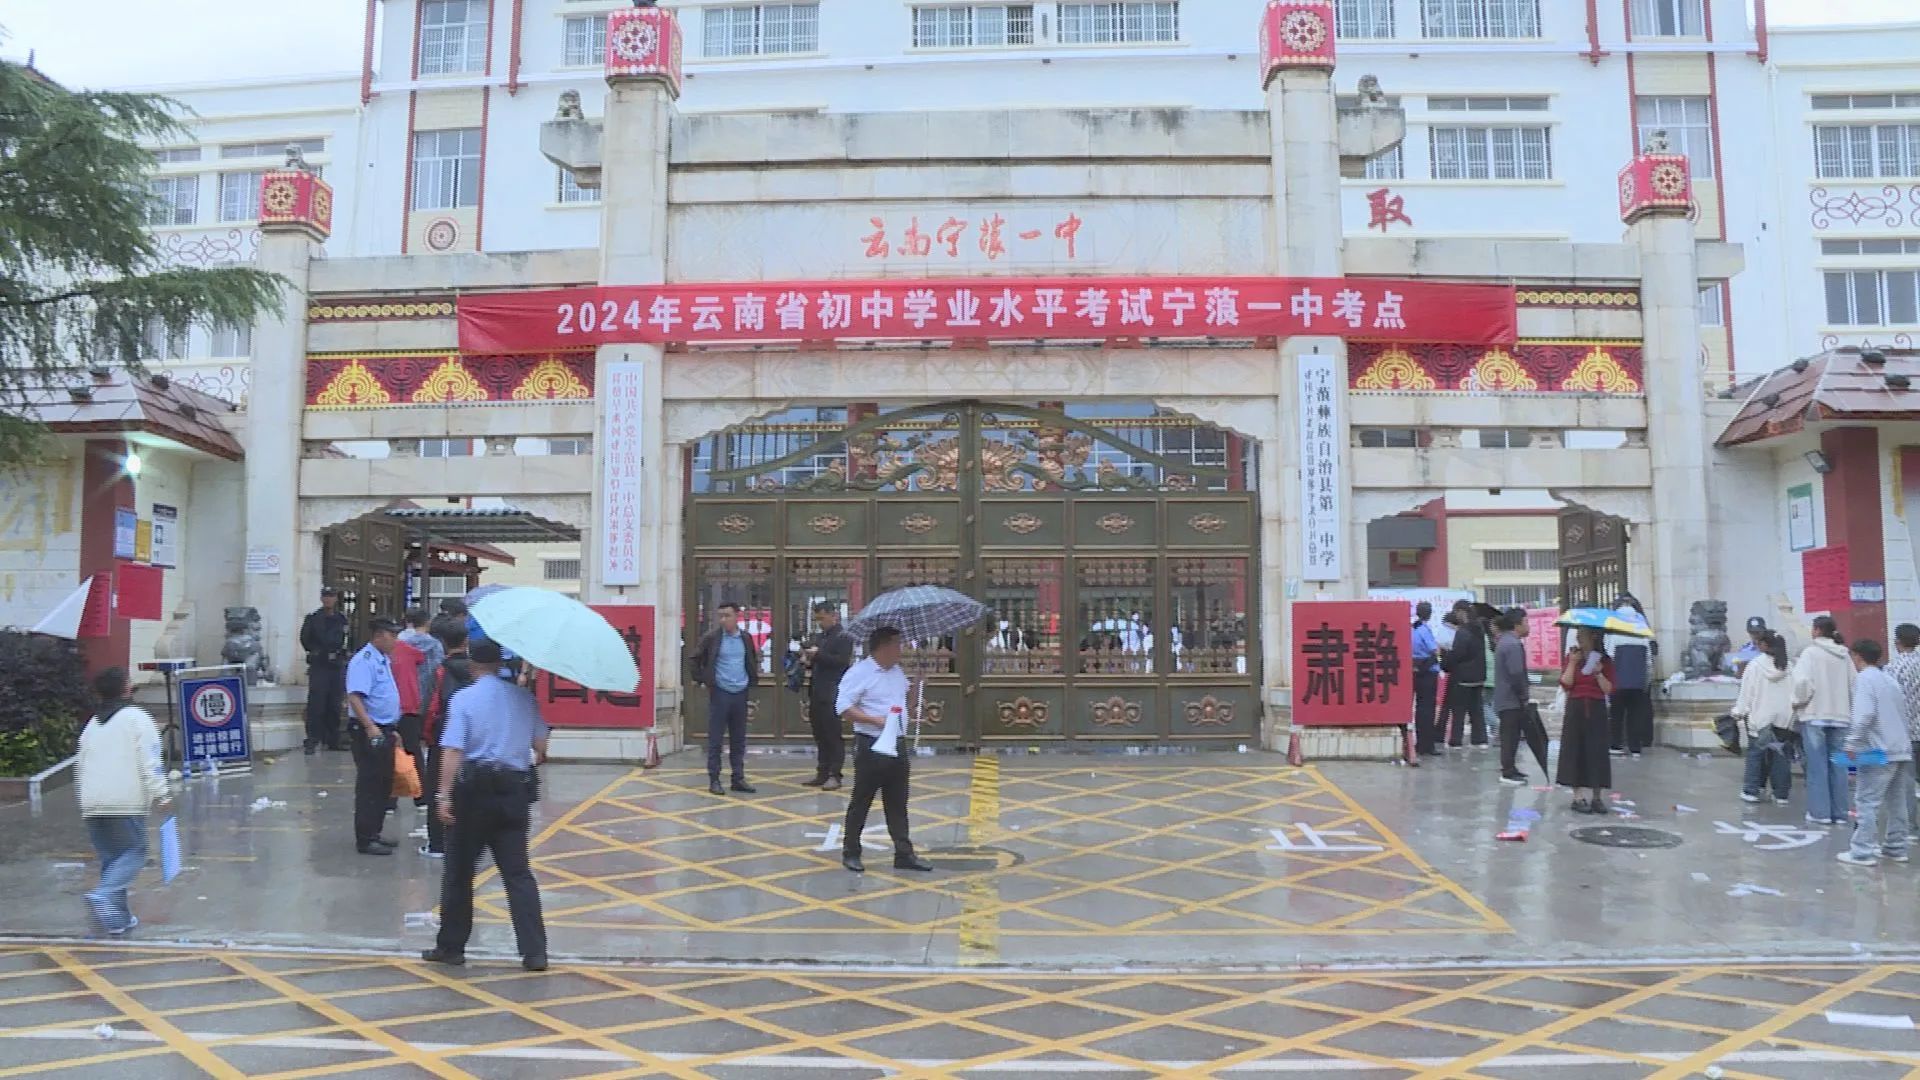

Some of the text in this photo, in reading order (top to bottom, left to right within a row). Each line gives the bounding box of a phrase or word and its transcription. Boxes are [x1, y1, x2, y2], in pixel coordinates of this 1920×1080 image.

[1366, 188, 1413, 233] 取
[860, 212, 1082, 260] 云南宁蒗一中
[556, 287, 1407, 335] 2024年云南省初中学业水平考试宁蒗一中考点
[1301, 621, 1401, 706] 肃静
[200, 692, 227, 718] 慢
